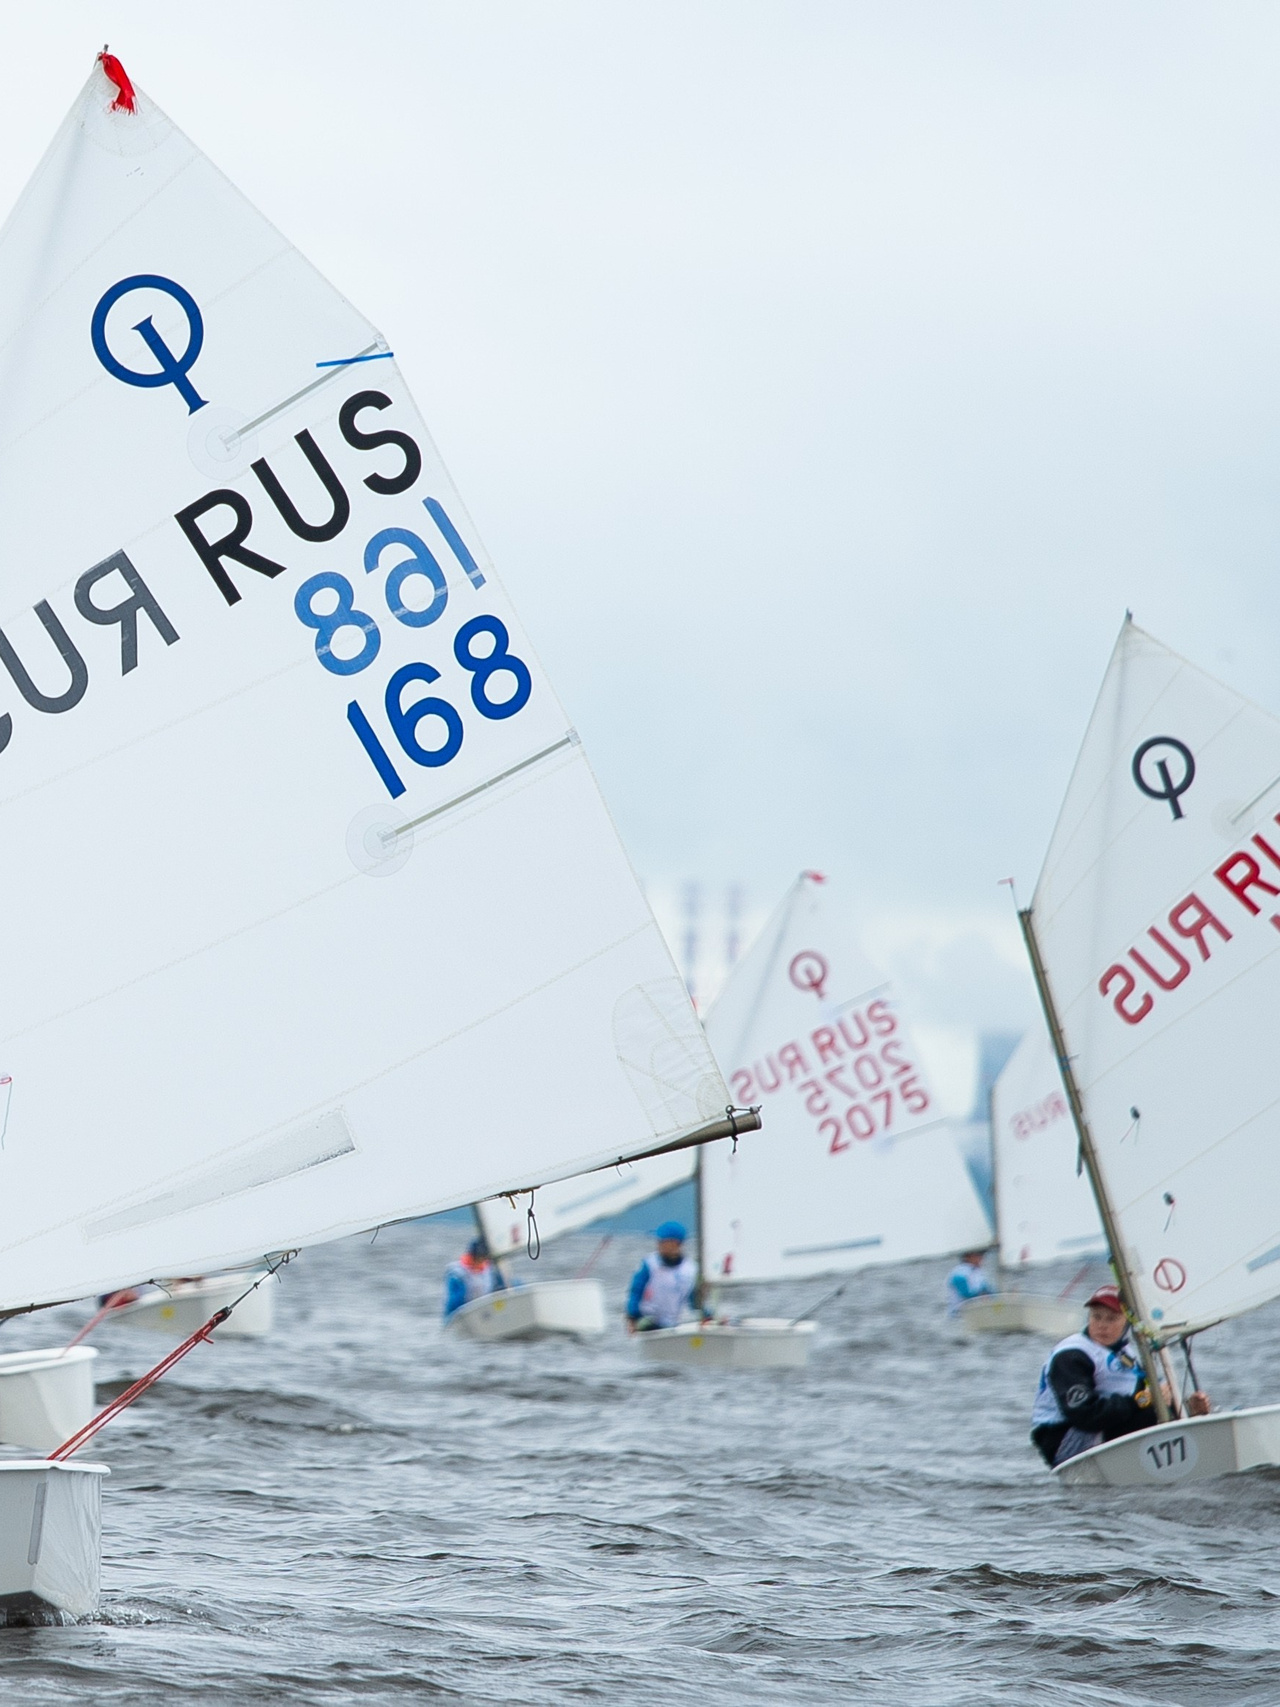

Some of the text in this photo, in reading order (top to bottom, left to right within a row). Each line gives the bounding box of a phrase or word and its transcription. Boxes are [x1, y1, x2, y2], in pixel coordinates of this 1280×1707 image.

[174, 390, 422, 607] RUS
[347, 614, 532, 800] 168
[811, 999, 897, 1065] RUS
[818, 1075, 930, 1156] 2075
[1147, 1436, 1187, 1469] 177
